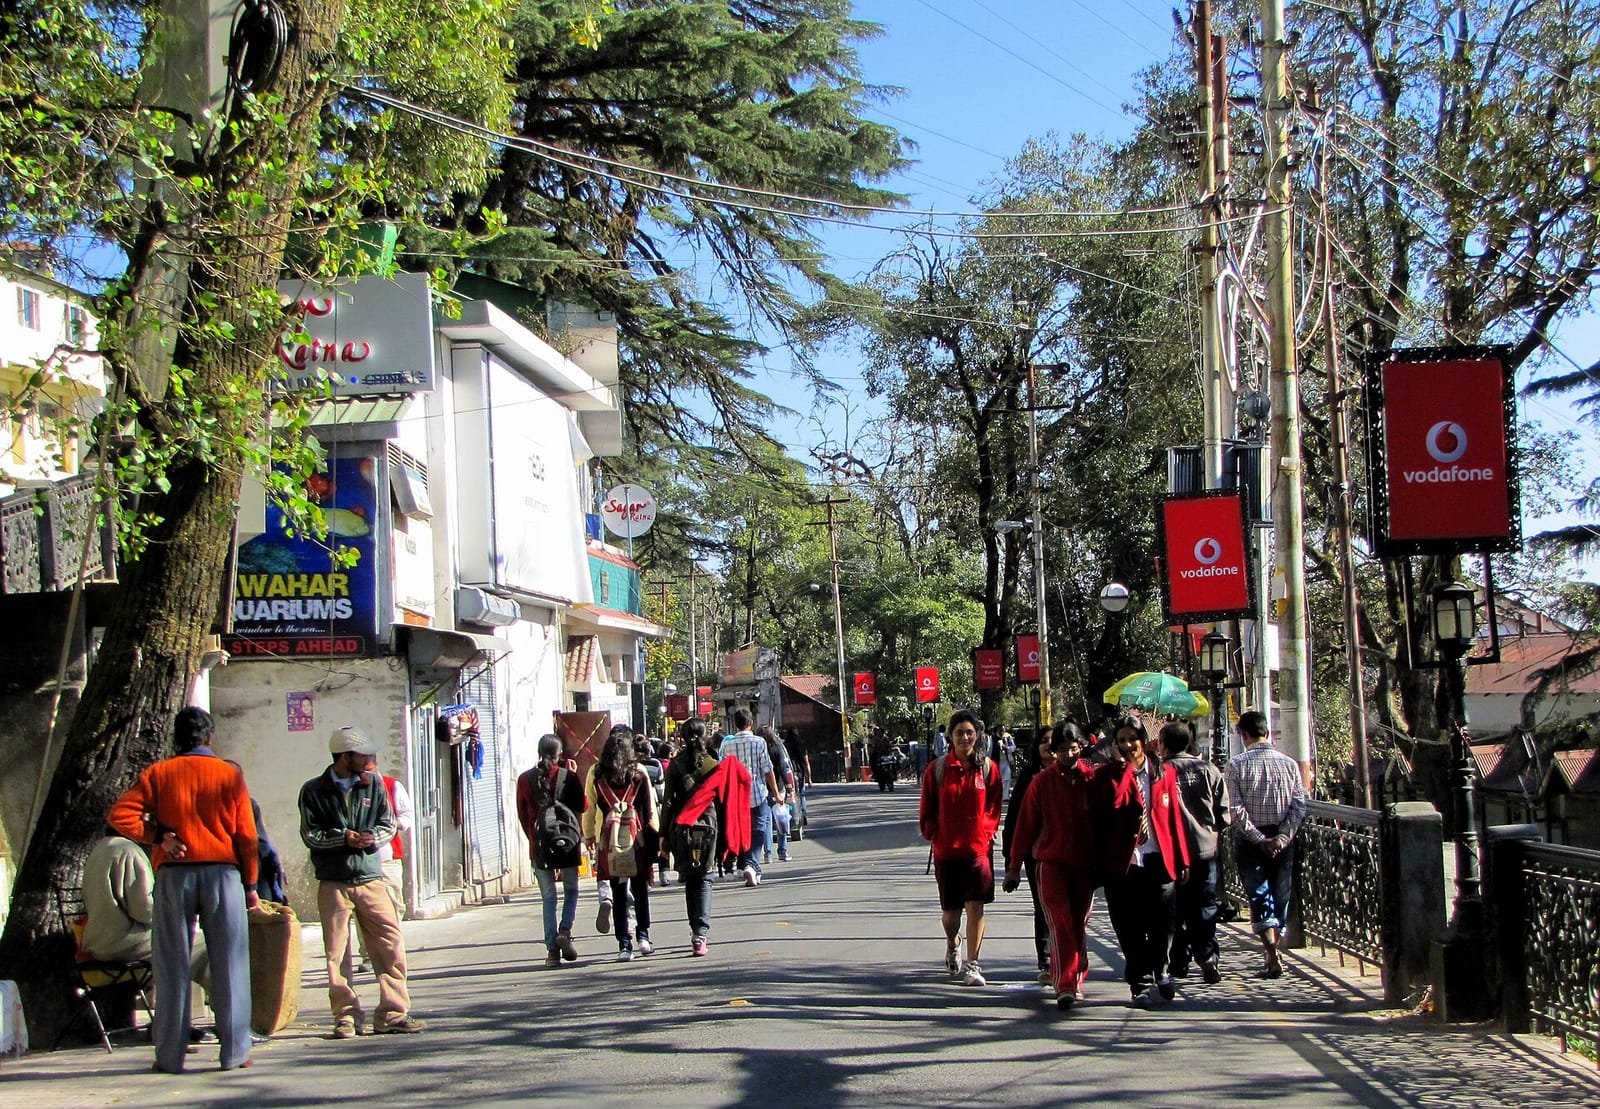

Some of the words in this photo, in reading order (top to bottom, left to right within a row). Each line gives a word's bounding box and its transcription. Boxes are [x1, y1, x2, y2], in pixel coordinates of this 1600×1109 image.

[1403, 466, 1493, 483] vodafone
[605, 499, 647, 521] Sagar
[1180, 565, 1239, 579] vodafone
[236, 573, 349, 597] WAHAR
[234, 598, 353, 621] UARiUMS
[236, 625, 272, 634] window
[232, 640, 289, 655] STEPS
[296, 639, 358, 654] AHEAD
